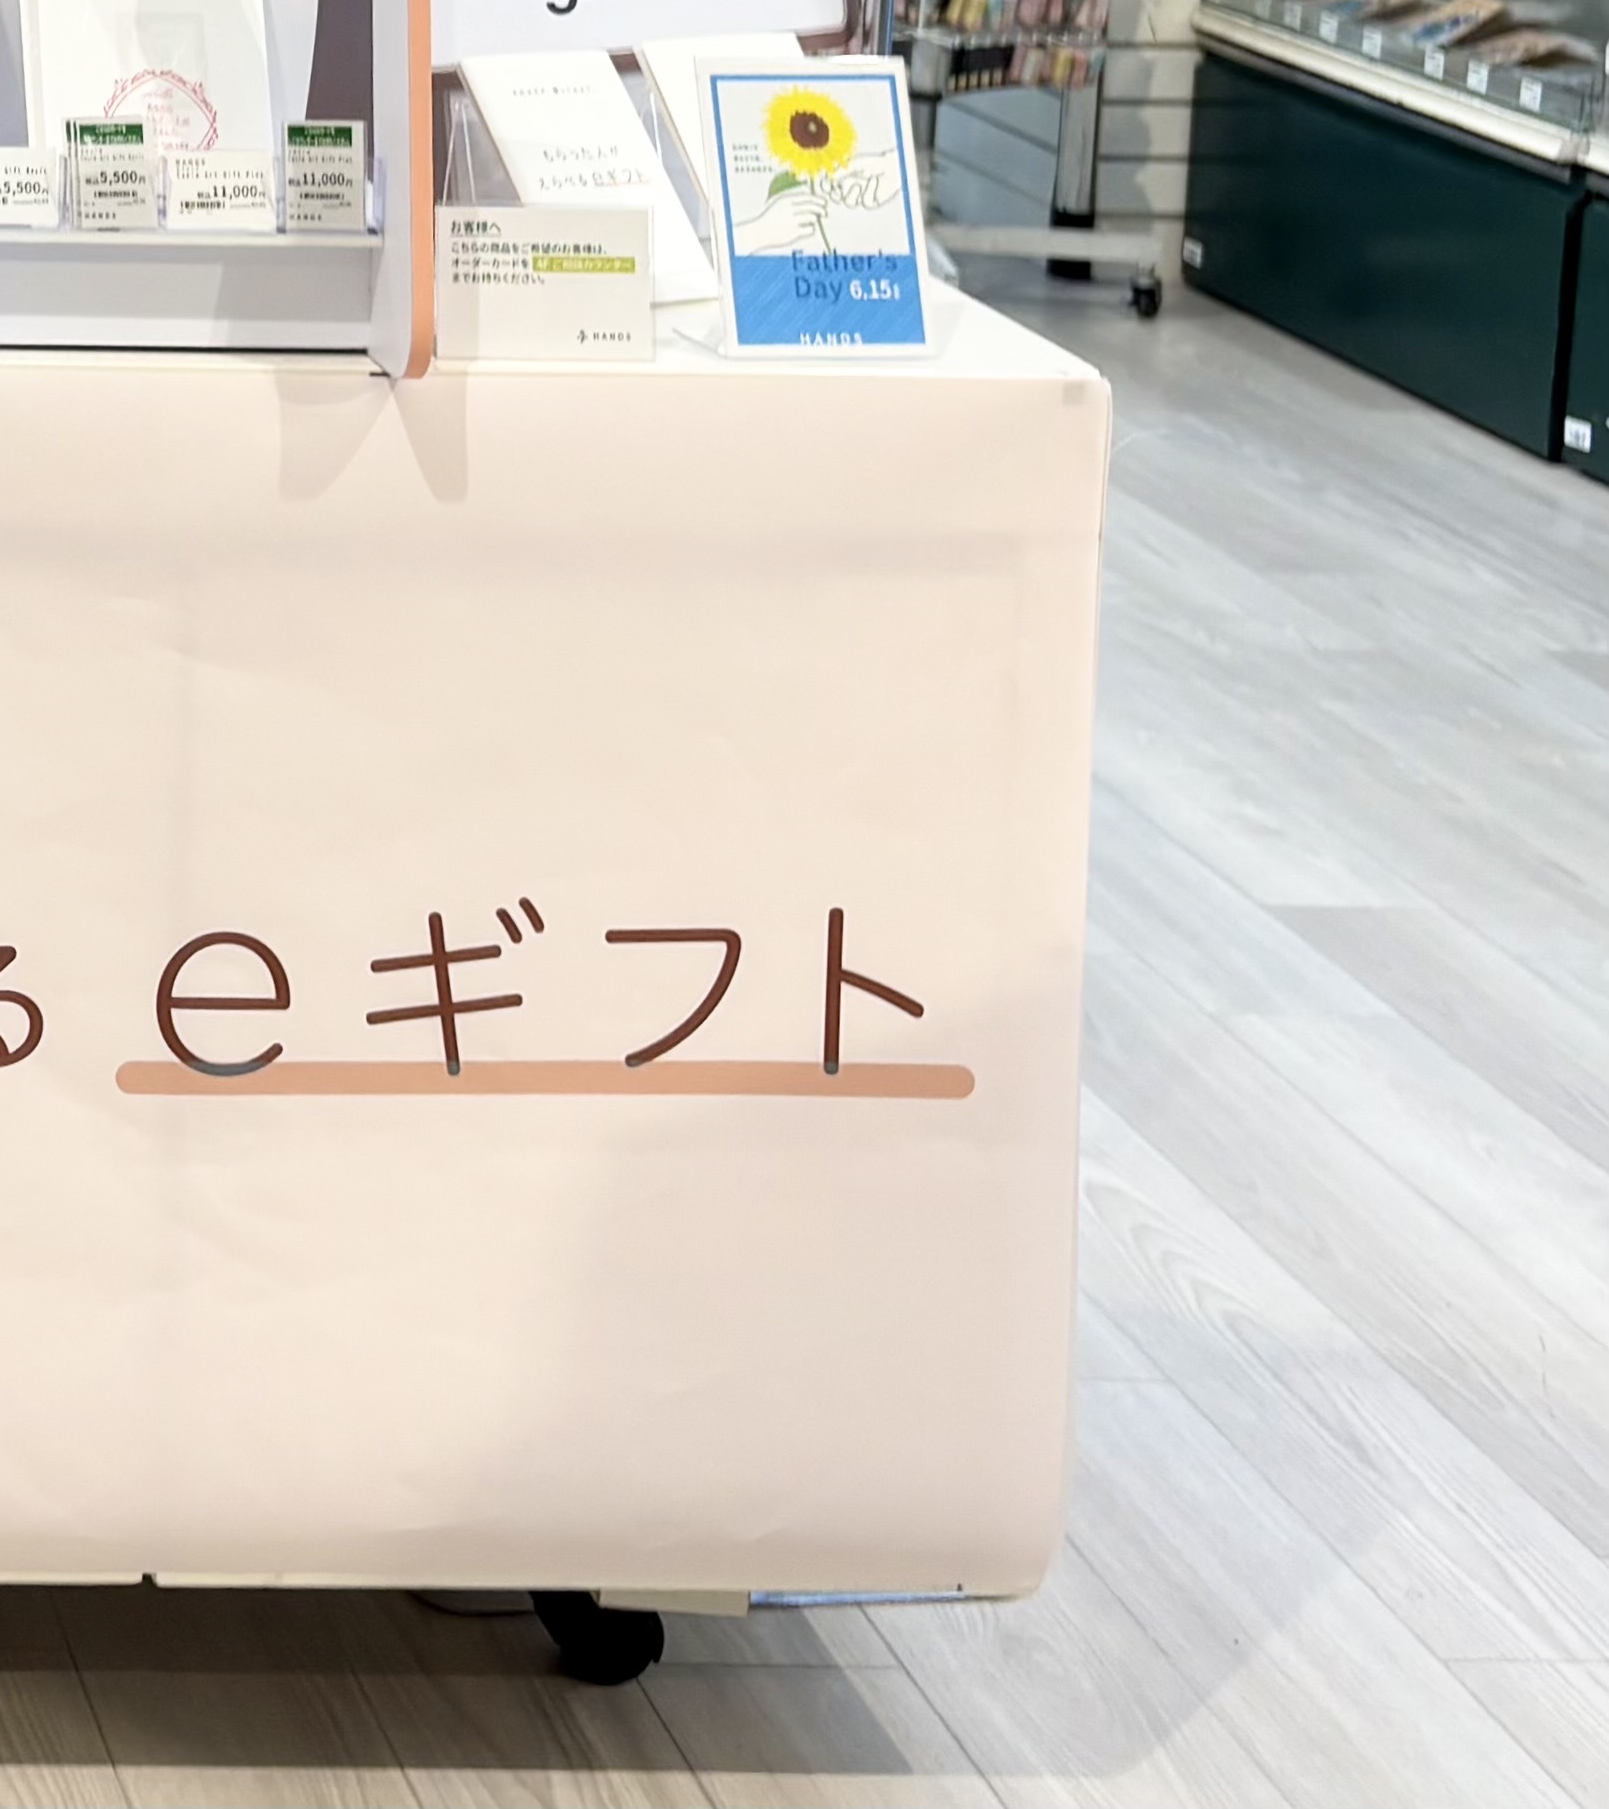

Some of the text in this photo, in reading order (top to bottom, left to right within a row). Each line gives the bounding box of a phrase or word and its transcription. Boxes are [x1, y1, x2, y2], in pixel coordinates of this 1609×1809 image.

[450, 220, 502, 236] お客様へ
[451, 258, 530, 269] オーダーカードを
[791, 248, 899, 273] Father's
[452, 272, 545, 285] までお持ちください。
[794, 276, 892, 304] Day 6.15
[593, 331, 632, 341] HANDS
